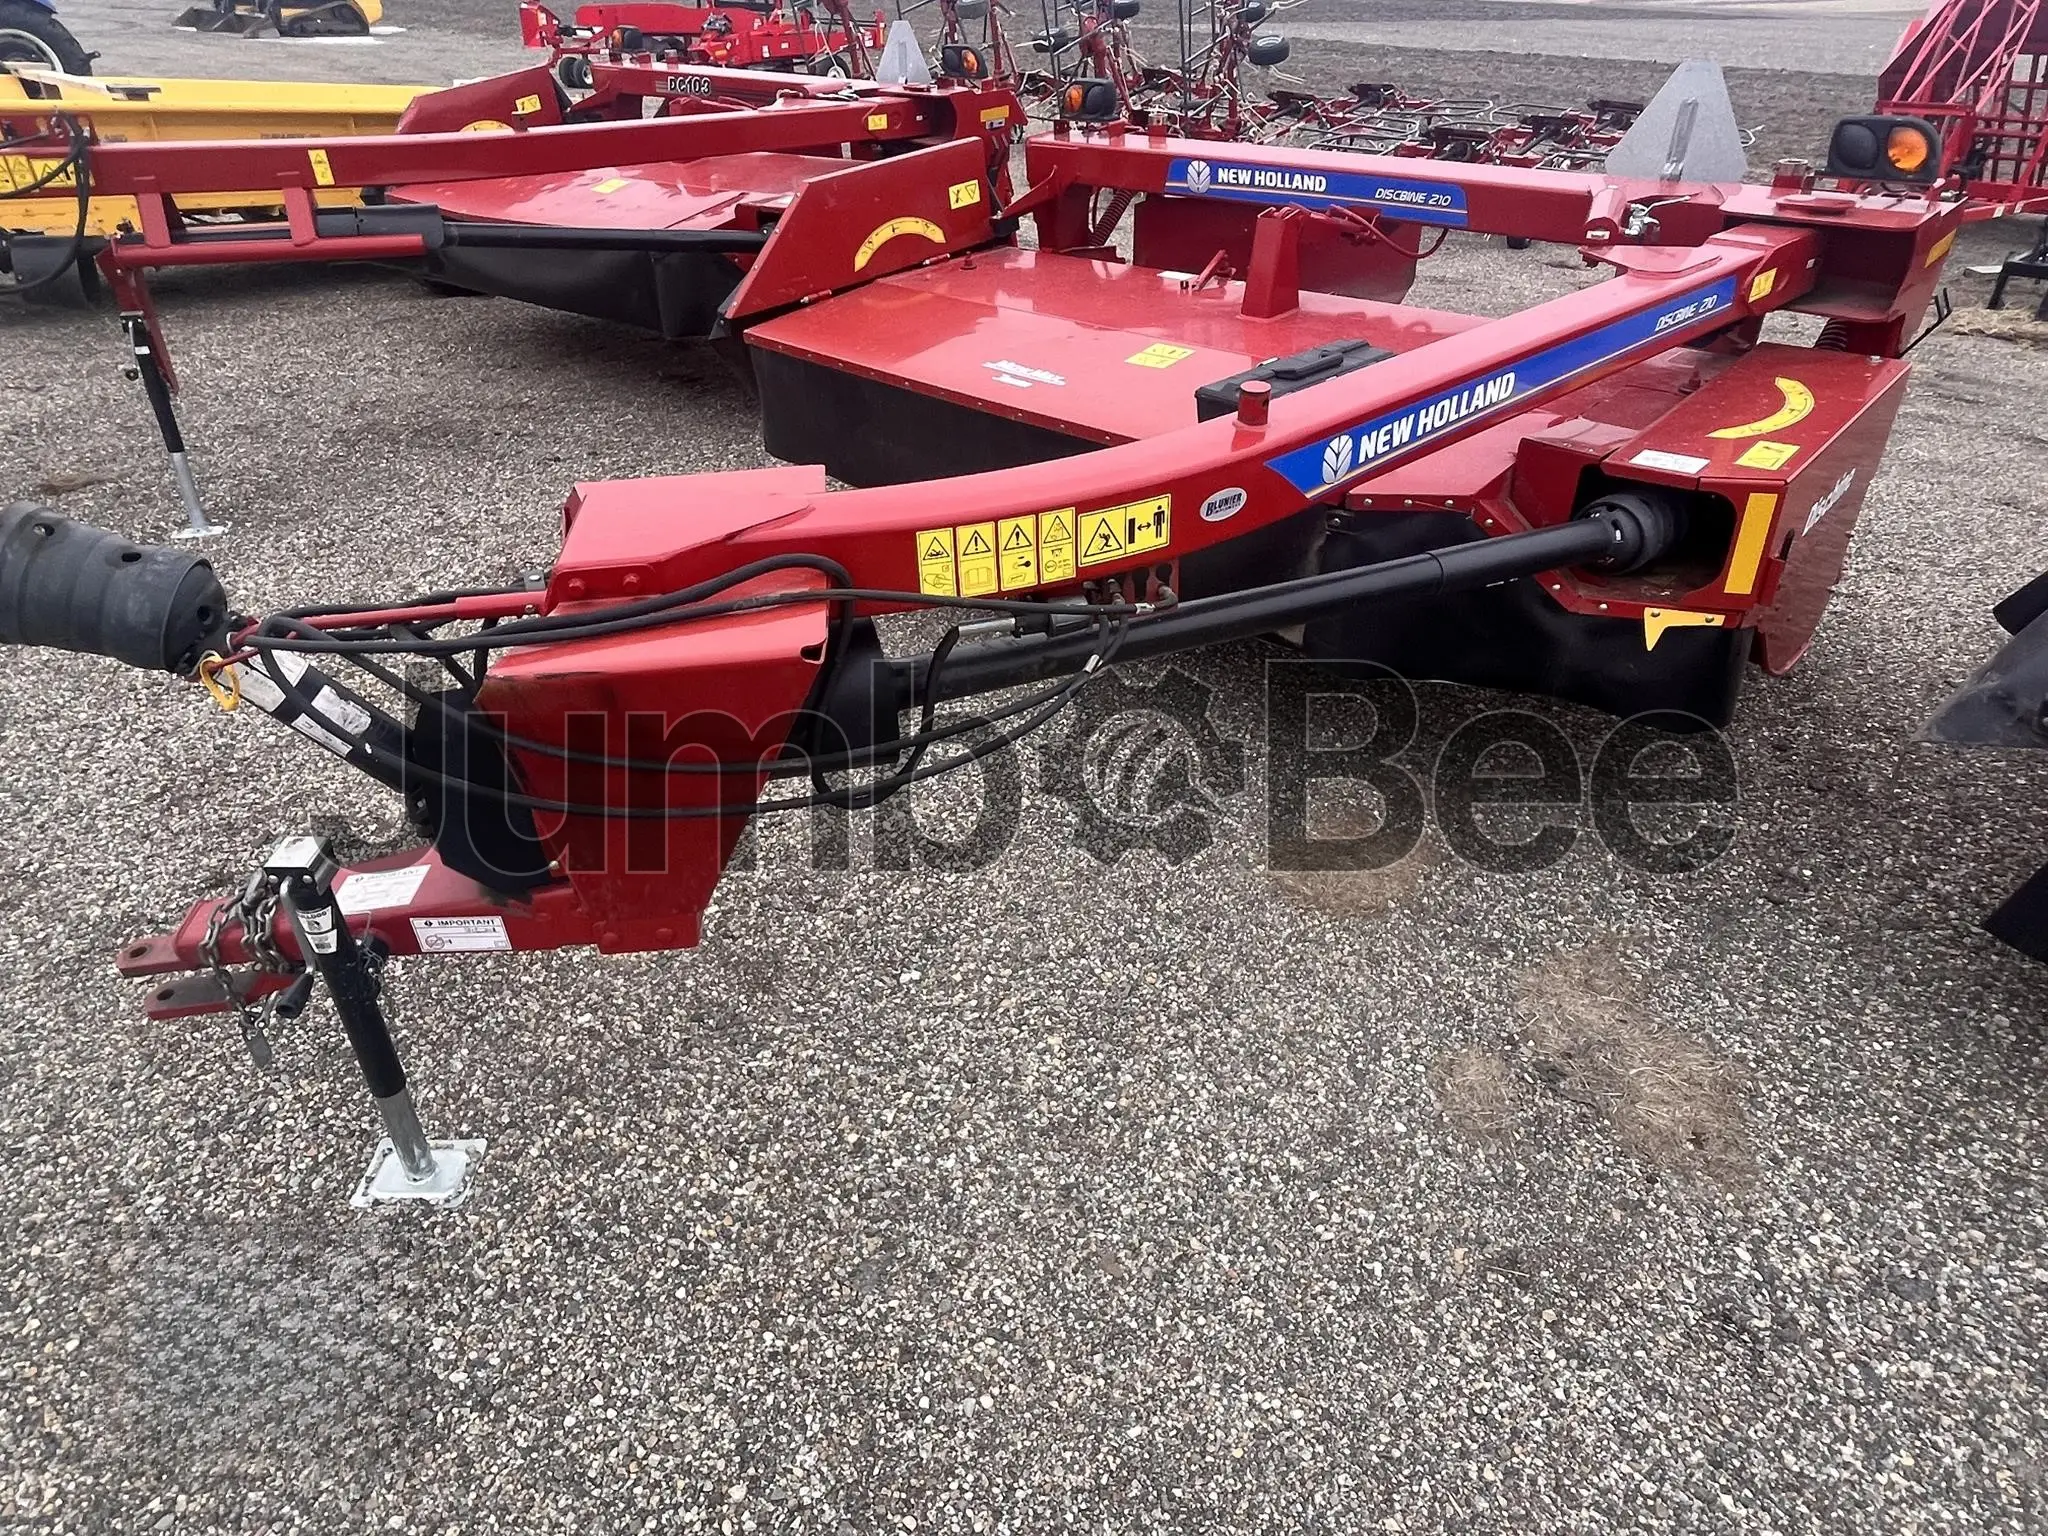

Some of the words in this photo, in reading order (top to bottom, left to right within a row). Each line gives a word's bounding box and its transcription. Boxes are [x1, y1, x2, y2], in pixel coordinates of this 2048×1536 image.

[668, 75, 711, 96] DC103
[1217, 167, 1253, 186] NEW
[1254, 170, 1327, 193] HOLLAND
[1375, 187, 1427, 204] DISCBINE
[1429, 192, 1452, 207] 210
[1654, 302, 1698, 332] DISCBINE
[1358, 413, 1415, 465] NEW
[1416, 371, 1516, 437] HOLLAND
[1206, 493, 1242, 517] BLUNIER
